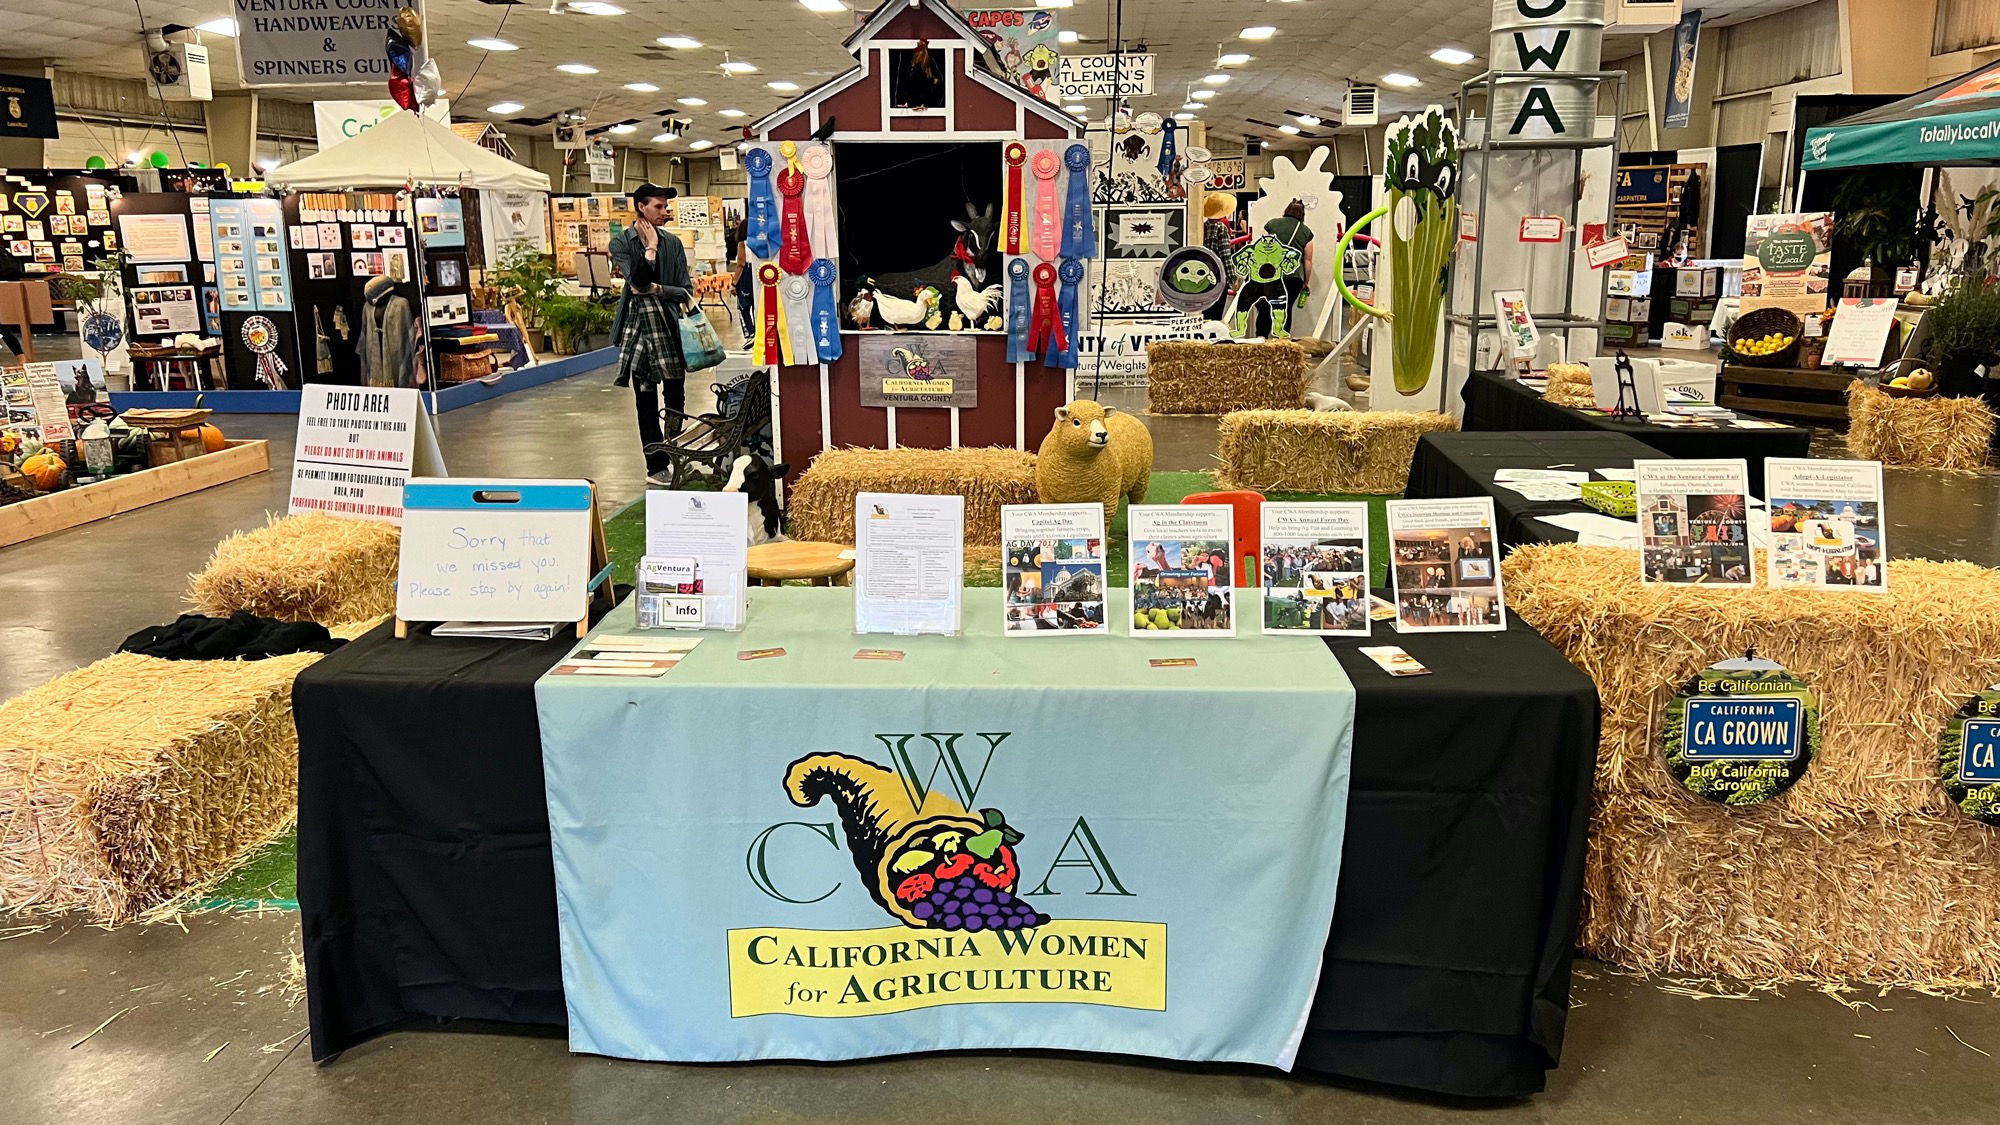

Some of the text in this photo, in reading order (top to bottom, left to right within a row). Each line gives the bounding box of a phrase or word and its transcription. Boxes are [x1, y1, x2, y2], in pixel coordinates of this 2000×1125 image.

[240, 0, 415, 12] VENTURA COUNTY
[322, 38, 336, 52] &
[254, 59, 347, 75] SPINNERS
[1080, 56, 1148, 68] COUNTY
[1776, 251, 1807, 264] Local
[1111, 333, 1126, 356] of
[326, 392, 389, 413] PHOTO AREA
[306, 417, 406, 432] FEEL FREE TO TAKE PHOTOS IN THIS AREA
[349, 434, 359, 443] BUT
[304, 445, 404, 462] PLEASE DO NOT SIT ON THE ANIMALS
[298, 469, 404, 487] SE PERMITE TOMAR FOTOGRAFIAS EN ESTA
[334, 486, 364, 498] AREA, PERO
[292, 497, 403, 518] PORFAVOR NO SE SIENTEN EN LOS ANIMALES
[448, 527, 550, 552] Sorry that
[1006, 540, 1018, 548] AG
[437, 558, 559, 574] we missed you.
[409, 575, 571, 600] Please stop by again!
[676, 606, 697, 615] Info
[1698, 680, 1792, 692] Be Californian
[1710, 706, 1775, 715] CALIFORNIA
[1978, 701, 1997, 712] Be
[1694, 721, 1788, 745] CA GROWN
[1972, 743, 1995, 768] CA
[1690, 765, 1790, 780] Buy California
[1714, 779, 1760, 791] Grown
[1967, 789, 1995, 804] Buy
[747, 928, 1148, 968] CALIFORNIA WOMEN
[784, 968, 1113, 1006] for AGRICULTURE
